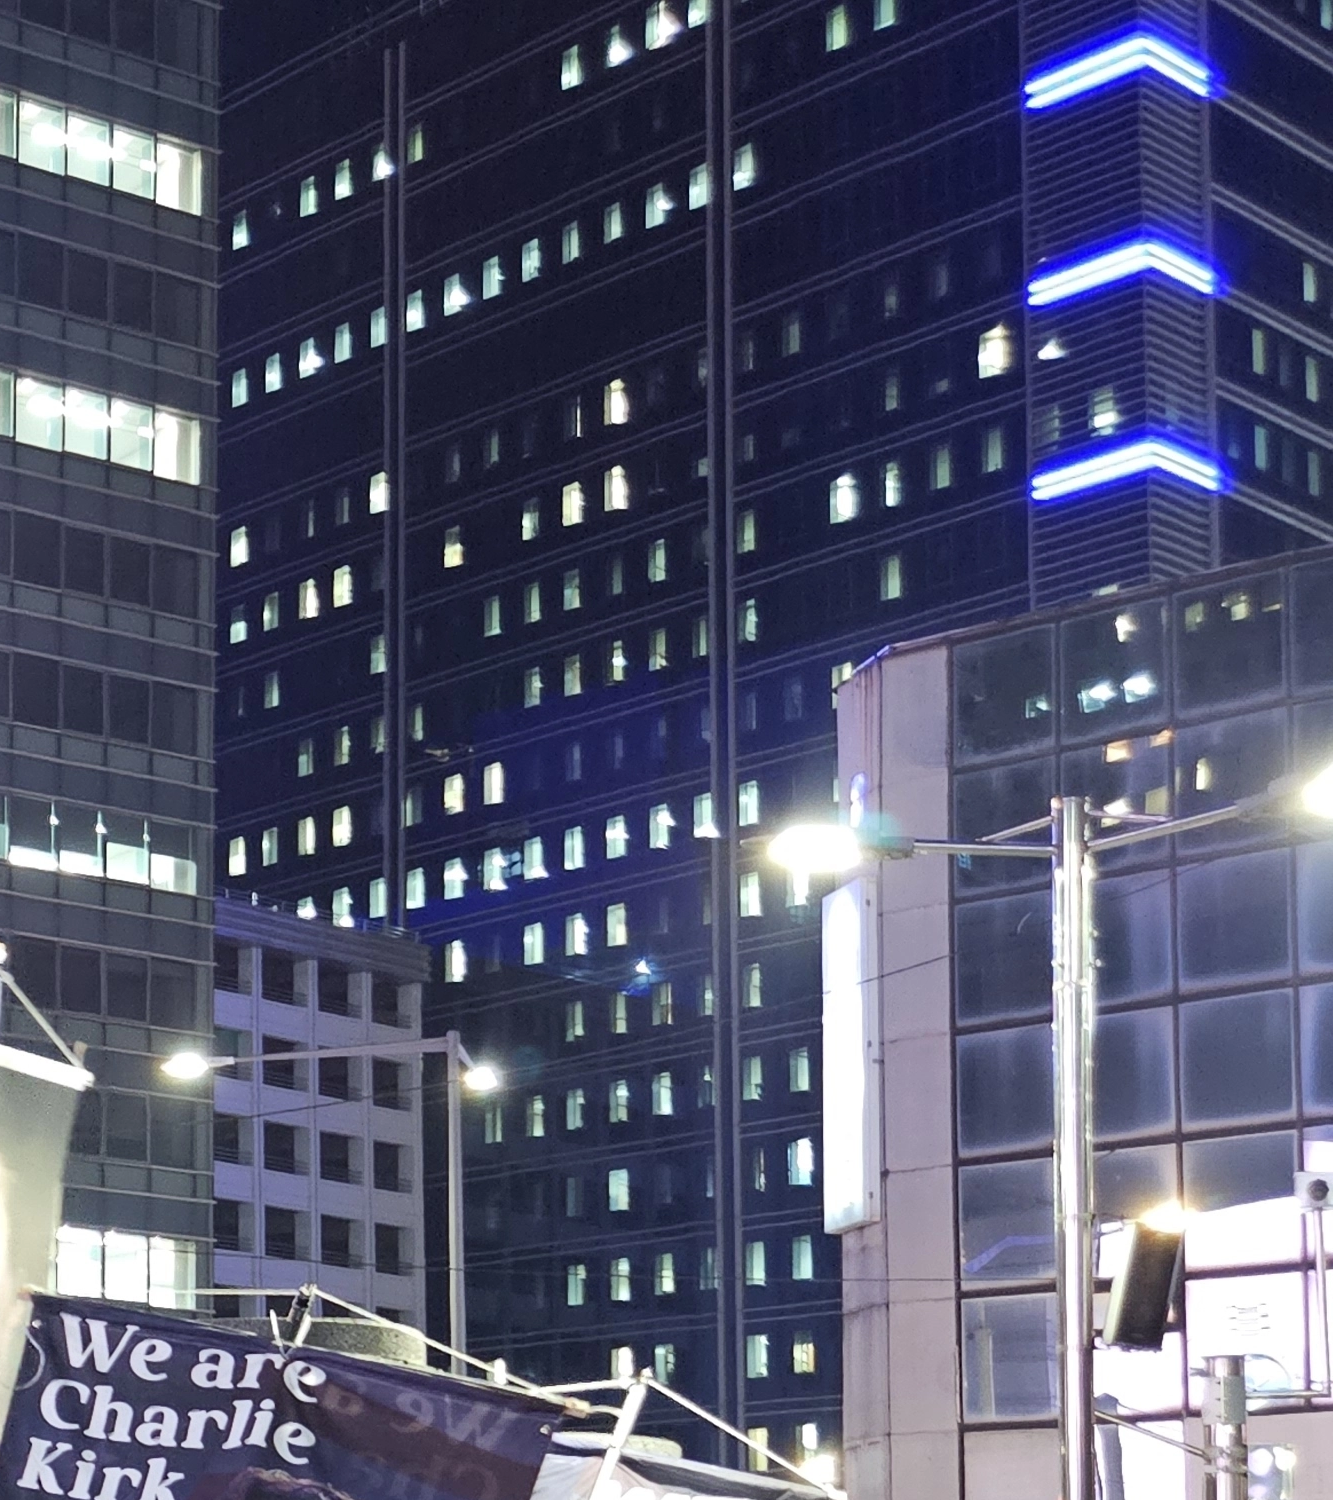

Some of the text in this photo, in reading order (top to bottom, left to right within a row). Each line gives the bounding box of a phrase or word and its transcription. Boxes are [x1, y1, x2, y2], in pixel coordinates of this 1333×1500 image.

[59, 1312, 173, 1382] We
[191, 1346, 328, 1404] are
[39, 1377, 317, 1466] Charlie
